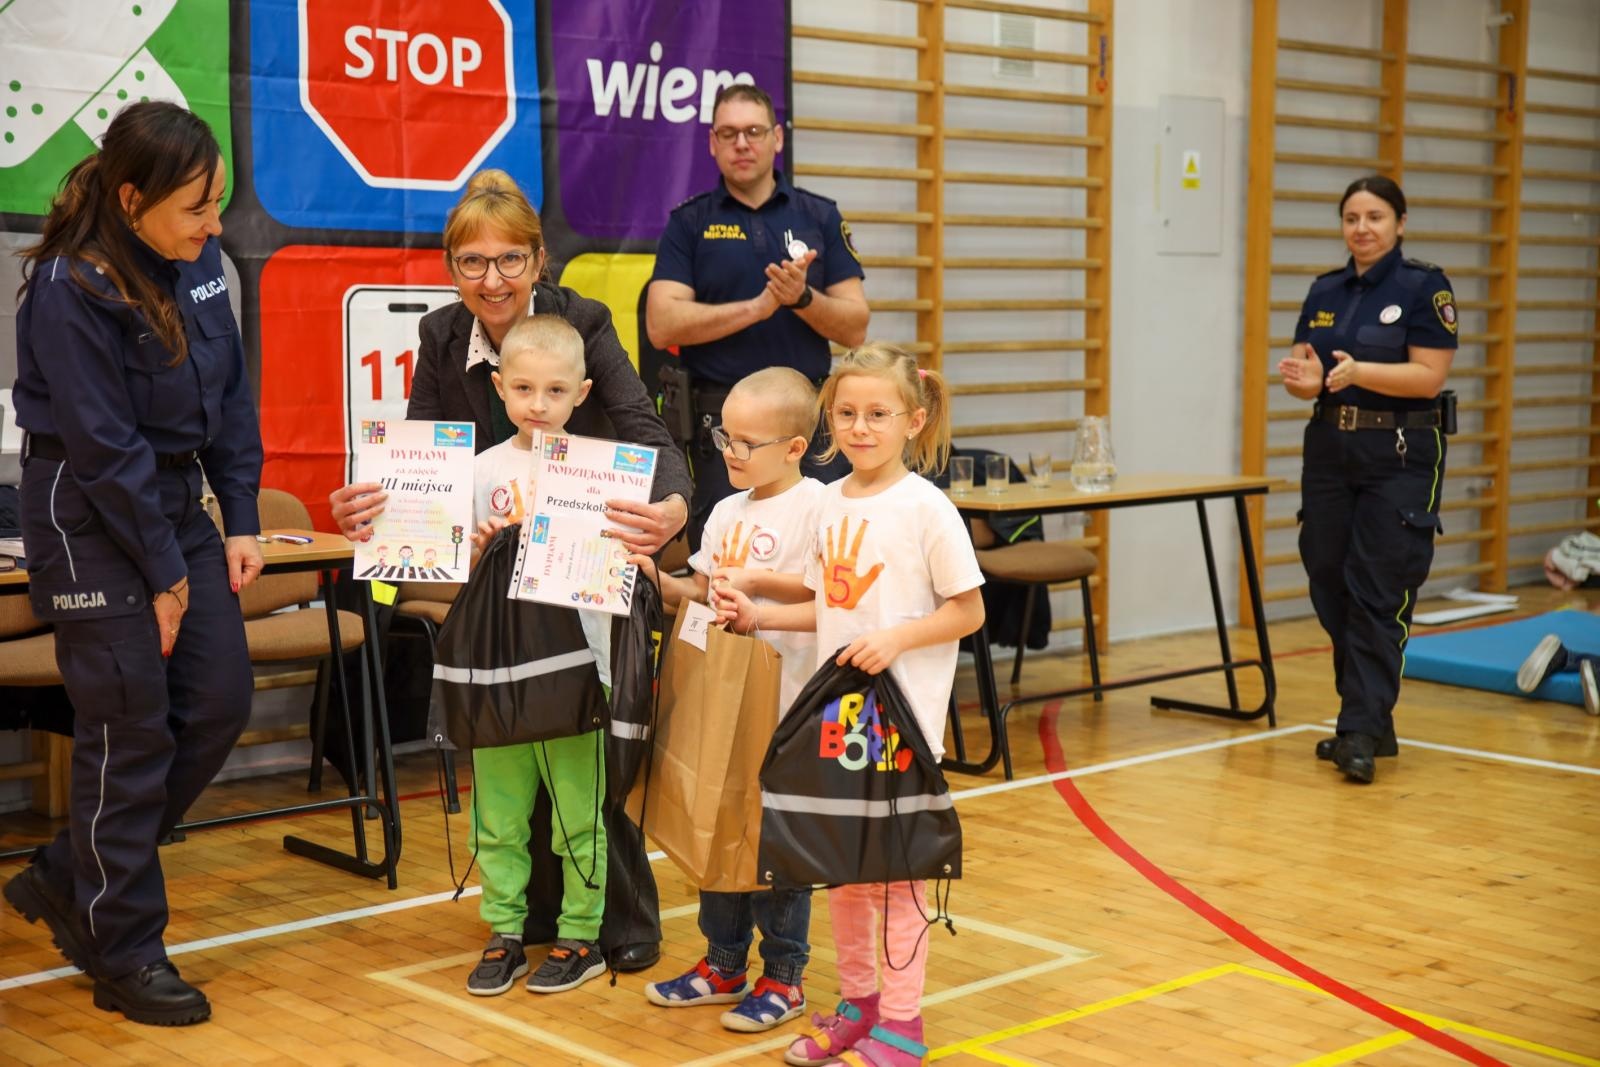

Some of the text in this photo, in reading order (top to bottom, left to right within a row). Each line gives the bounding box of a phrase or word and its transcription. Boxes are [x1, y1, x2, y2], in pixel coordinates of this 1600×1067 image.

[344, 25, 482, 87] STOP
[361, 350, 413, 400] 11
[390, 449, 447, 461] DYPLOM
[401, 478, 453, 495] miejsca
[828, 564, 852, 604] 5
[52, 591, 107, 610] POLICJA
